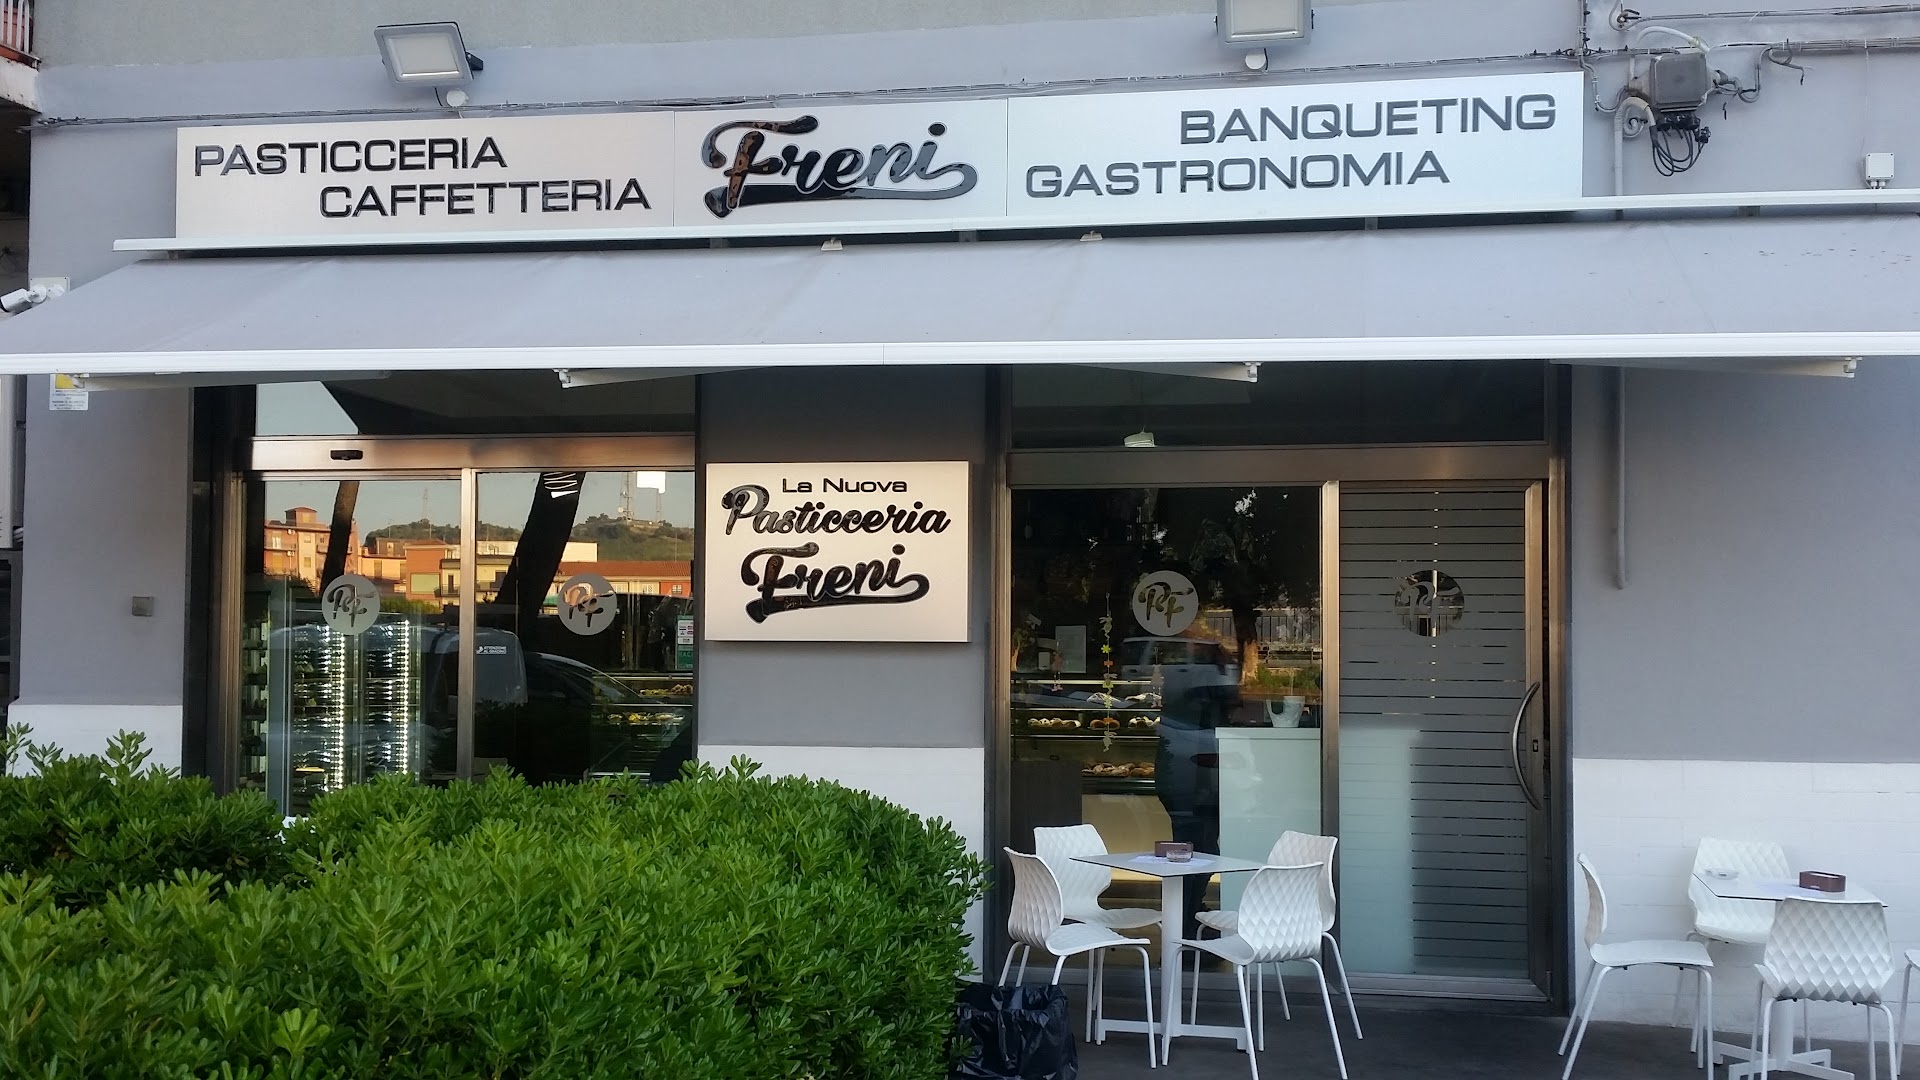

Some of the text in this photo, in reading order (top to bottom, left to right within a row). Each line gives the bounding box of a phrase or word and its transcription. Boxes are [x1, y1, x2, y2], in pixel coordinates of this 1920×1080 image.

[1180, 94, 1556, 144] BANQUETING
[195, 137, 508, 176] PASTICCERIA
[701, 115, 977, 219] Freni
[1026, 151, 1450, 198] GASTRONOMIA
[320, 178, 652, 218] CAFFETTERIA
[721, 484, 951, 535] Pasticceria
[783, 478, 907, 493] La Nuova
[741, 542, 930, 624] Freni
